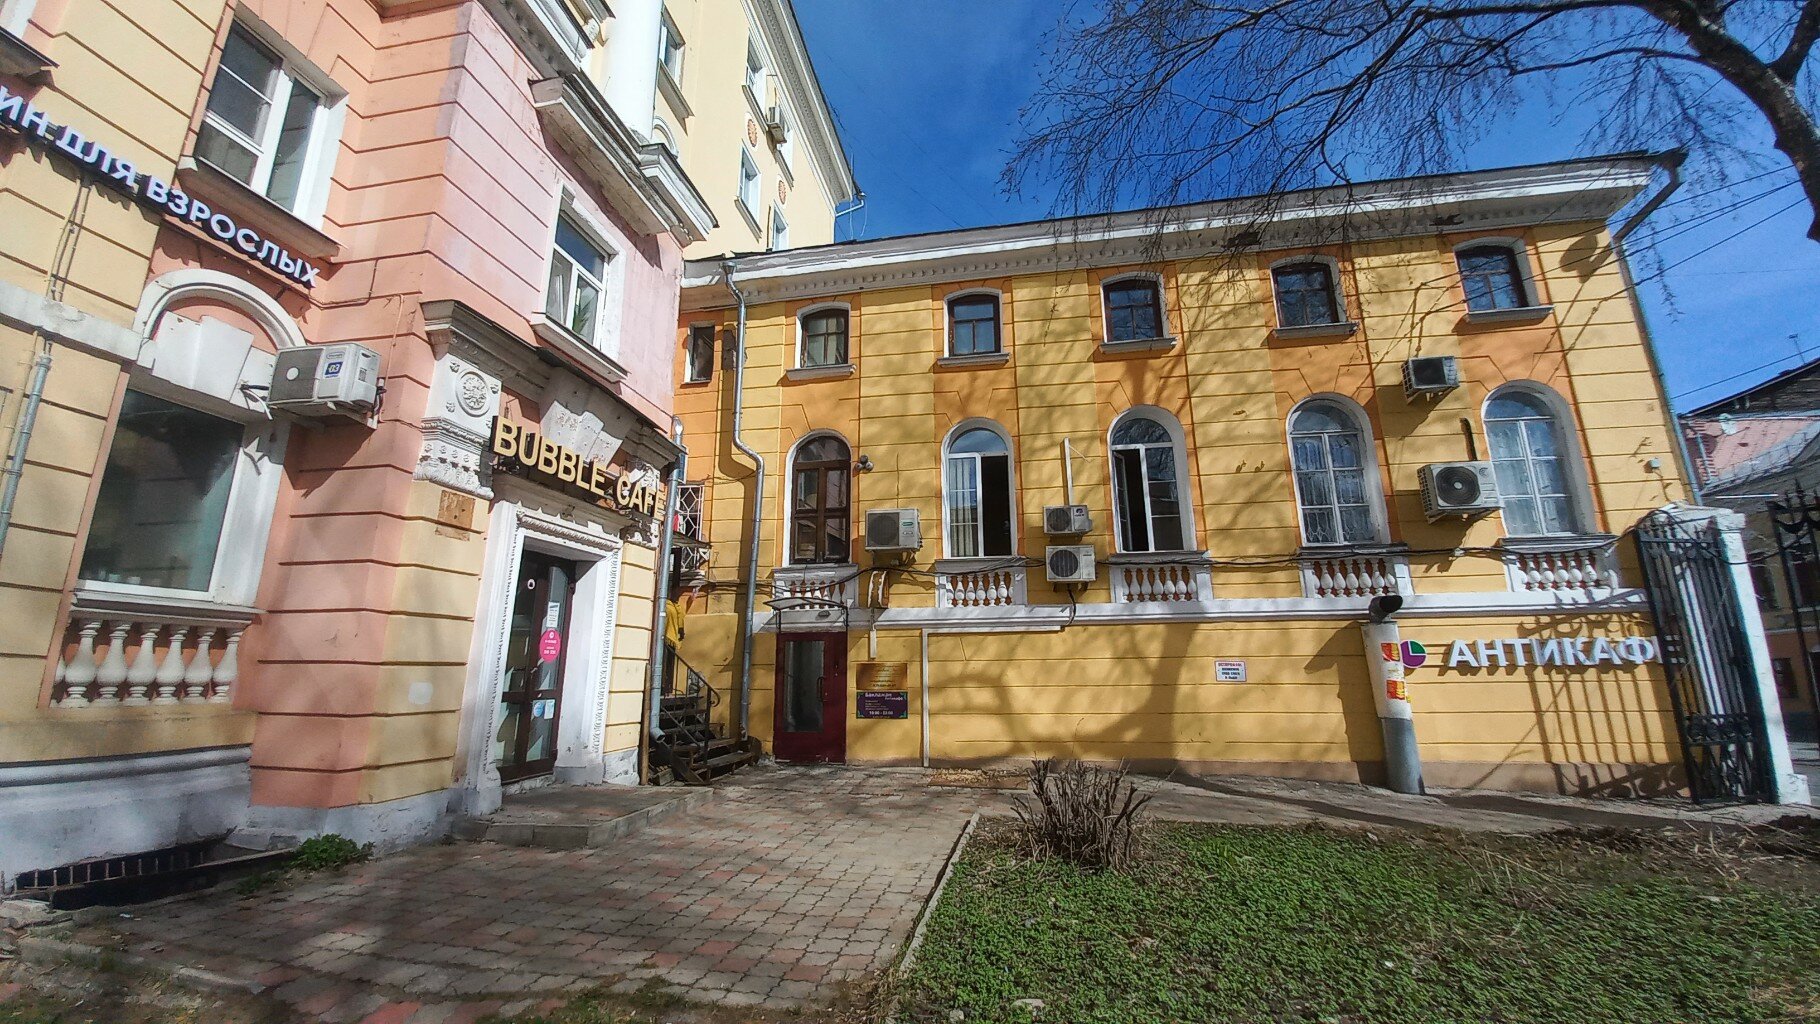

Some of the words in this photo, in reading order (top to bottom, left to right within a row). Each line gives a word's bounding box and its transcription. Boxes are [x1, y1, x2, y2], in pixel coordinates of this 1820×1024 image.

[56, 131, 138, 187] ДЛЯ
[146, 174, 322, 289] ВЗРОСЛЫХ
[493, 417, 607, 495] BUBBLE
[616, 475, 667, 521] CAFE
